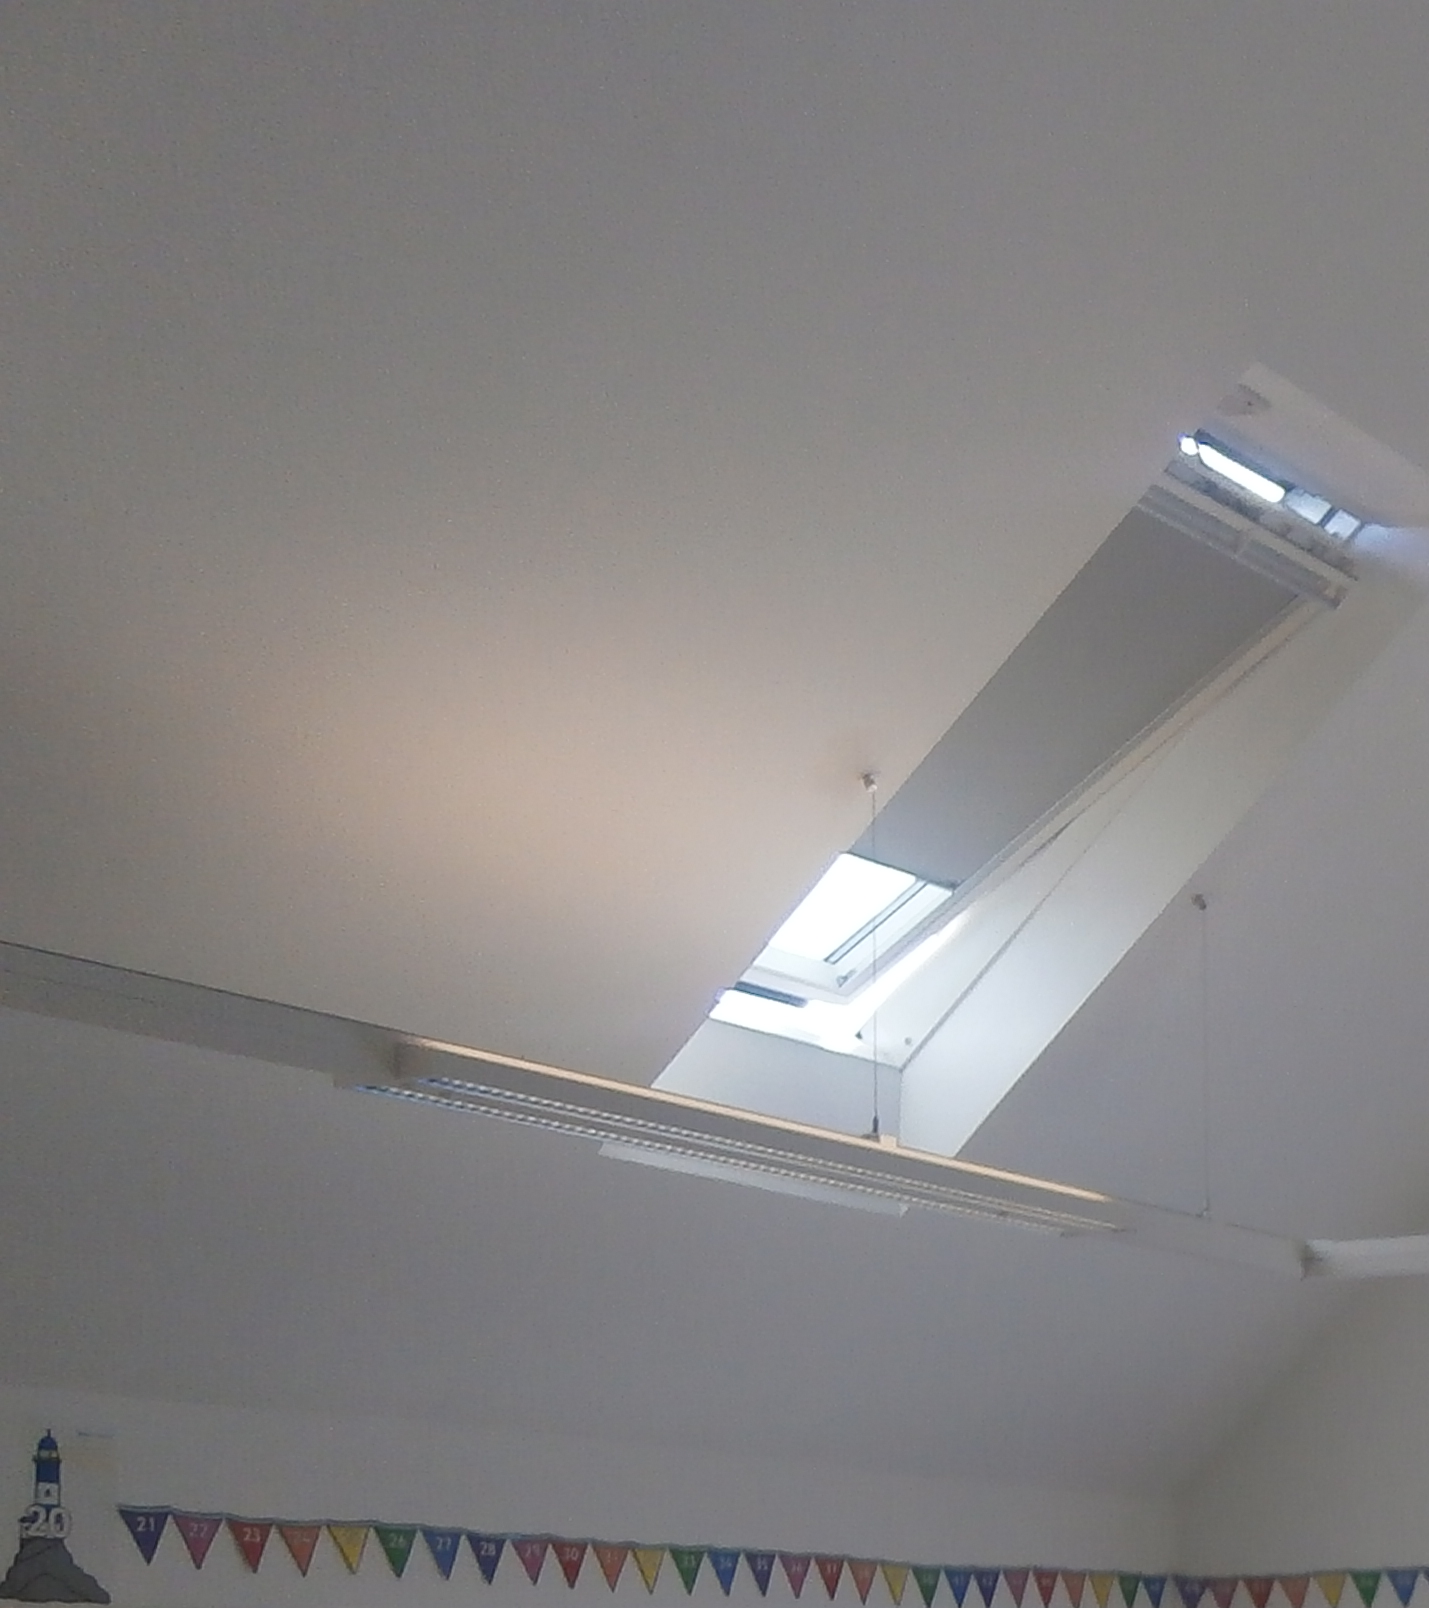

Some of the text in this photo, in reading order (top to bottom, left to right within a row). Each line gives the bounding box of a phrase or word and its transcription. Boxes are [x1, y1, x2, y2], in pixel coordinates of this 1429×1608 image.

[26, 1504, 71, 1538] 20
[135, 1517, 155, 1532] 21
[189, 1524, 208, 1537] 22
[242, 1527, 261, 1541] 23
[435, 1537, 451, 1550] 27
[480, 1541, 496, 1556] 28
[562, 1548, 579, 1560] 30
